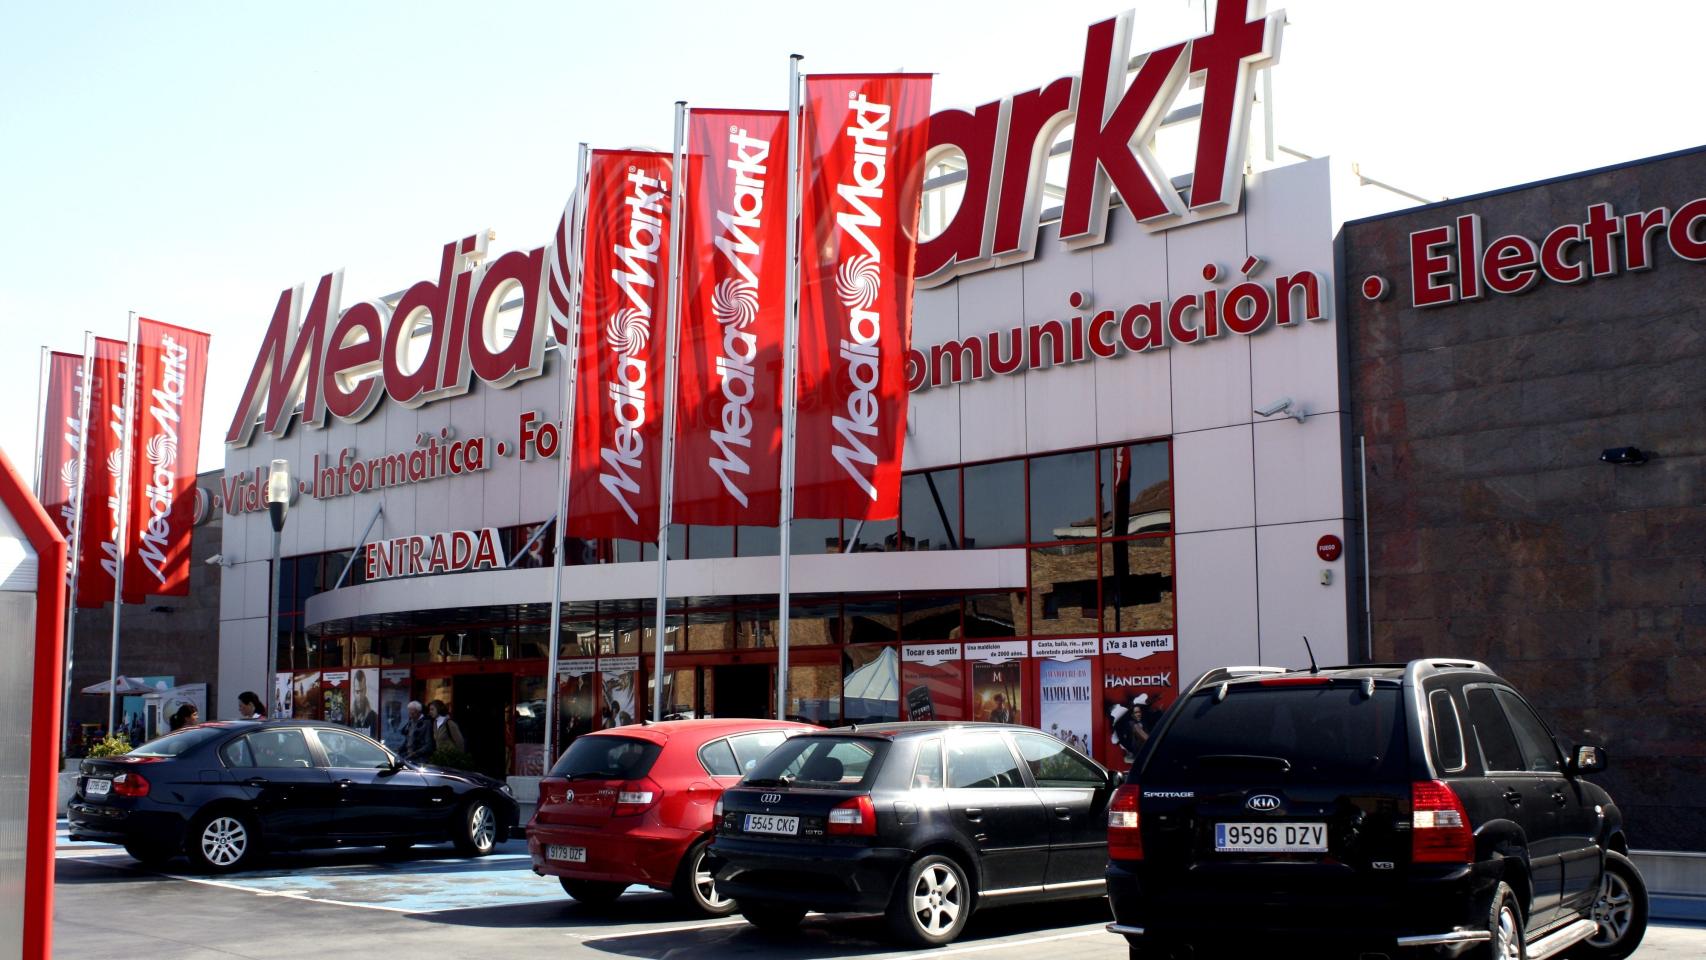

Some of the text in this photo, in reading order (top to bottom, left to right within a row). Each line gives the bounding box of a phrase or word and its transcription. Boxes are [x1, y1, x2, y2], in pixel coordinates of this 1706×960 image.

[903, 0, 1265, 280] arkt
[832, 93, 891, 502] Media Markt
[709, 128, 770, 508] Media Markt
[225, 233, 548, 445] Media
[600, 168, 667, 525] Media Markt
[221, 466, 271, 515] Vide
[312, 428, 485, 499] Informática
[904, 255, 1322, 394] omunicación
[138, 334, 188, 584] Media Markt
[366, 528, 498, 581] ENTRADA
[906, 647, 958, 657] Tocar es sentir
[1106, 640, 1119, 650] ¡Ya
[1129, 639, 1138, 648] la
[1140, 637, 1168, 648] venta!
[1104, 672, 1172, 688] HANCOCK
[1043, 686, 1090, 702] MAMMA MIA!
[1143, 791, 1195, 799] SPORTAGE
[1253, 798, 1275, 808] KIA
[751, 816, 795, 832] 5545 CKG
[1228, 826, 1324, 845] 9596 DZV
[550, 845, 584, 860] 9179 DZF
